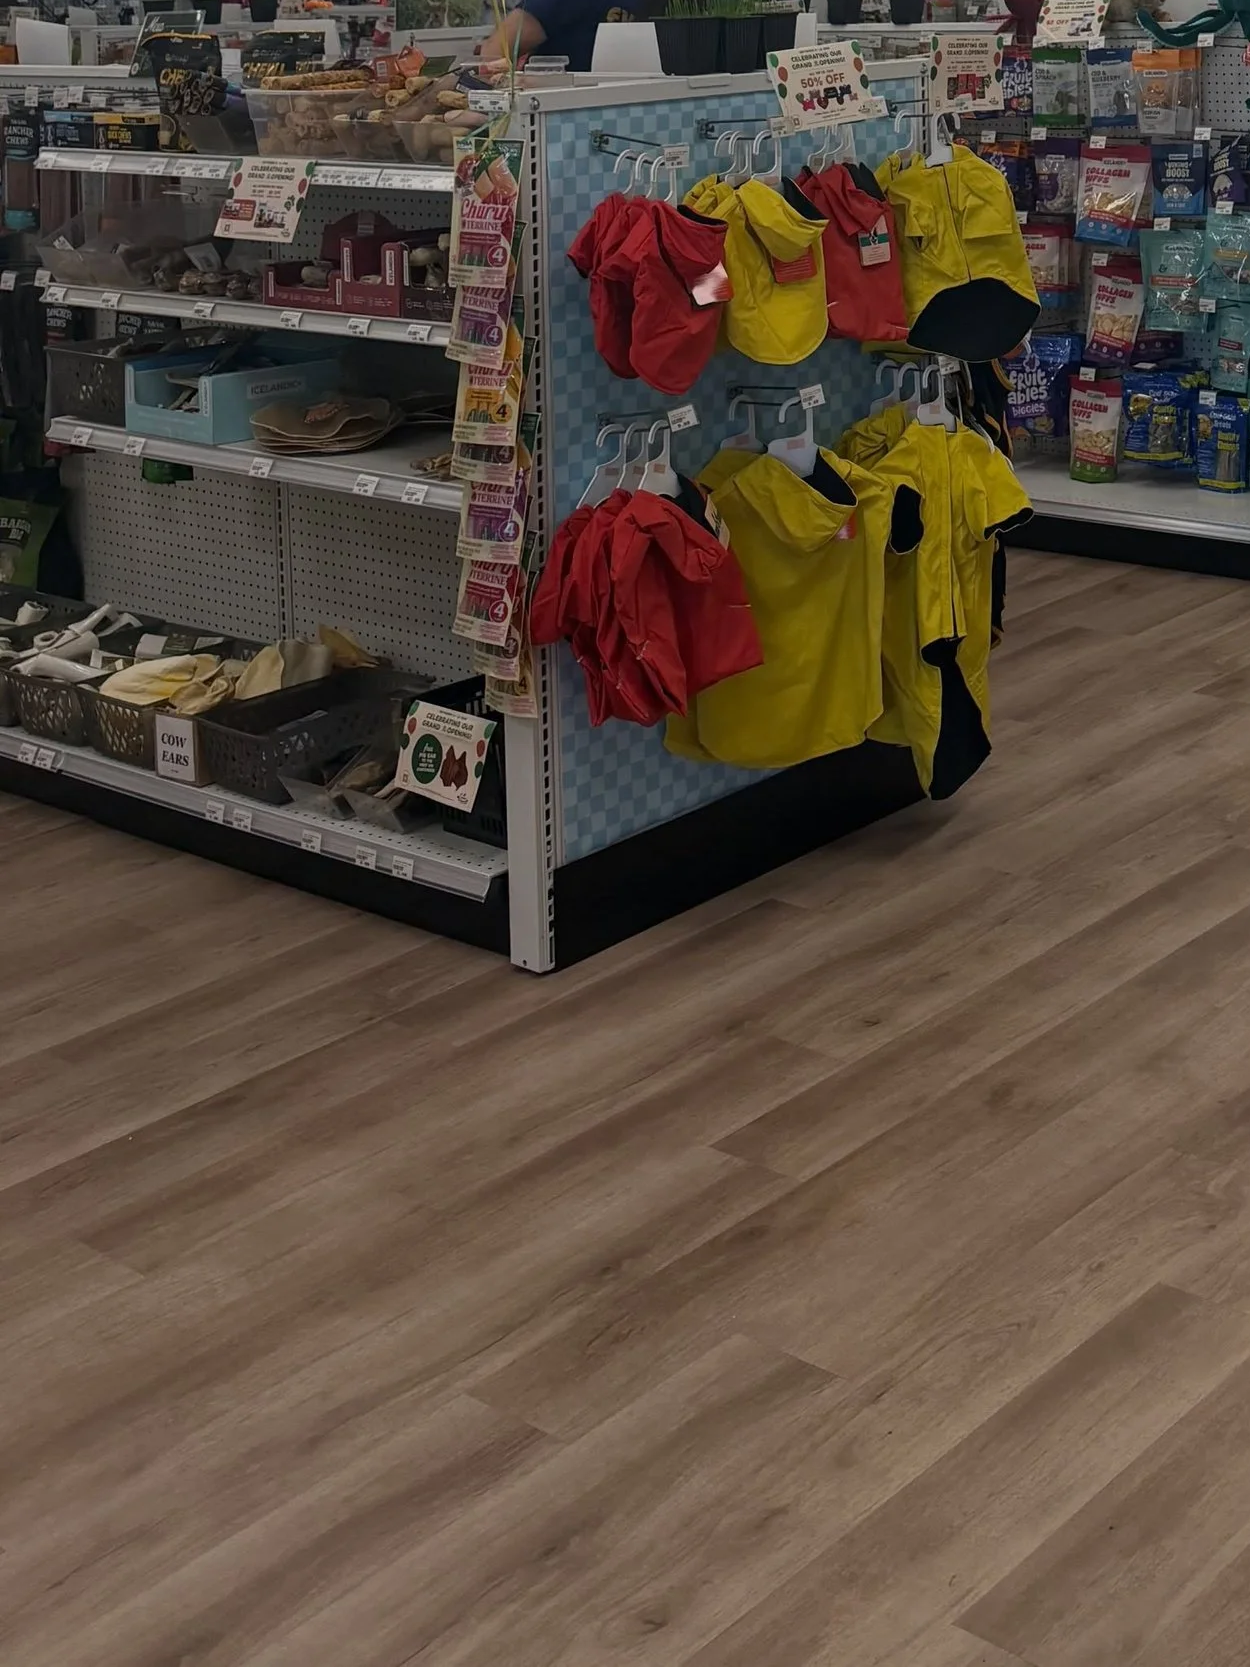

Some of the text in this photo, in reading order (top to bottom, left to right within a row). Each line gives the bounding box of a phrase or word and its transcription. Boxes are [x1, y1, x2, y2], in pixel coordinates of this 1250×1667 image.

[791, 51, 829, 63] CELEBRATING
[791, 62, 812, 70] GRAND
[801, 73, 845, 88] 50% OFF
[1002, 66, 1033, 84] fruit
[1085, 166, 1131, 178] COLLAGEN
[1165, 168, 1190, 178] BOOST
[462, 199, 509, 220] Churu
[466, 221, 501, 231] TERRINE
[492, 247, 504, 262] 4
[1097, 285, 1134, 299] COLLAGEN
[488, 327, 500, 342] 4
[1009, 369, 1047, 389] fruit
[1007, 386, 1049, 404] ables
[496, 404, 508, 418] 4
[1071, 399, 1109, 413] COLLAGEN
[504, 523, 515, 537] 4
[494, 602, 505, 617] 4
[422, 720, 441, 731] GRAND
[425, 712, 474, 731] CELEBRATING OUR
[161, 733, 187, 748] COW
[162, 750, 190, 767] EARS
